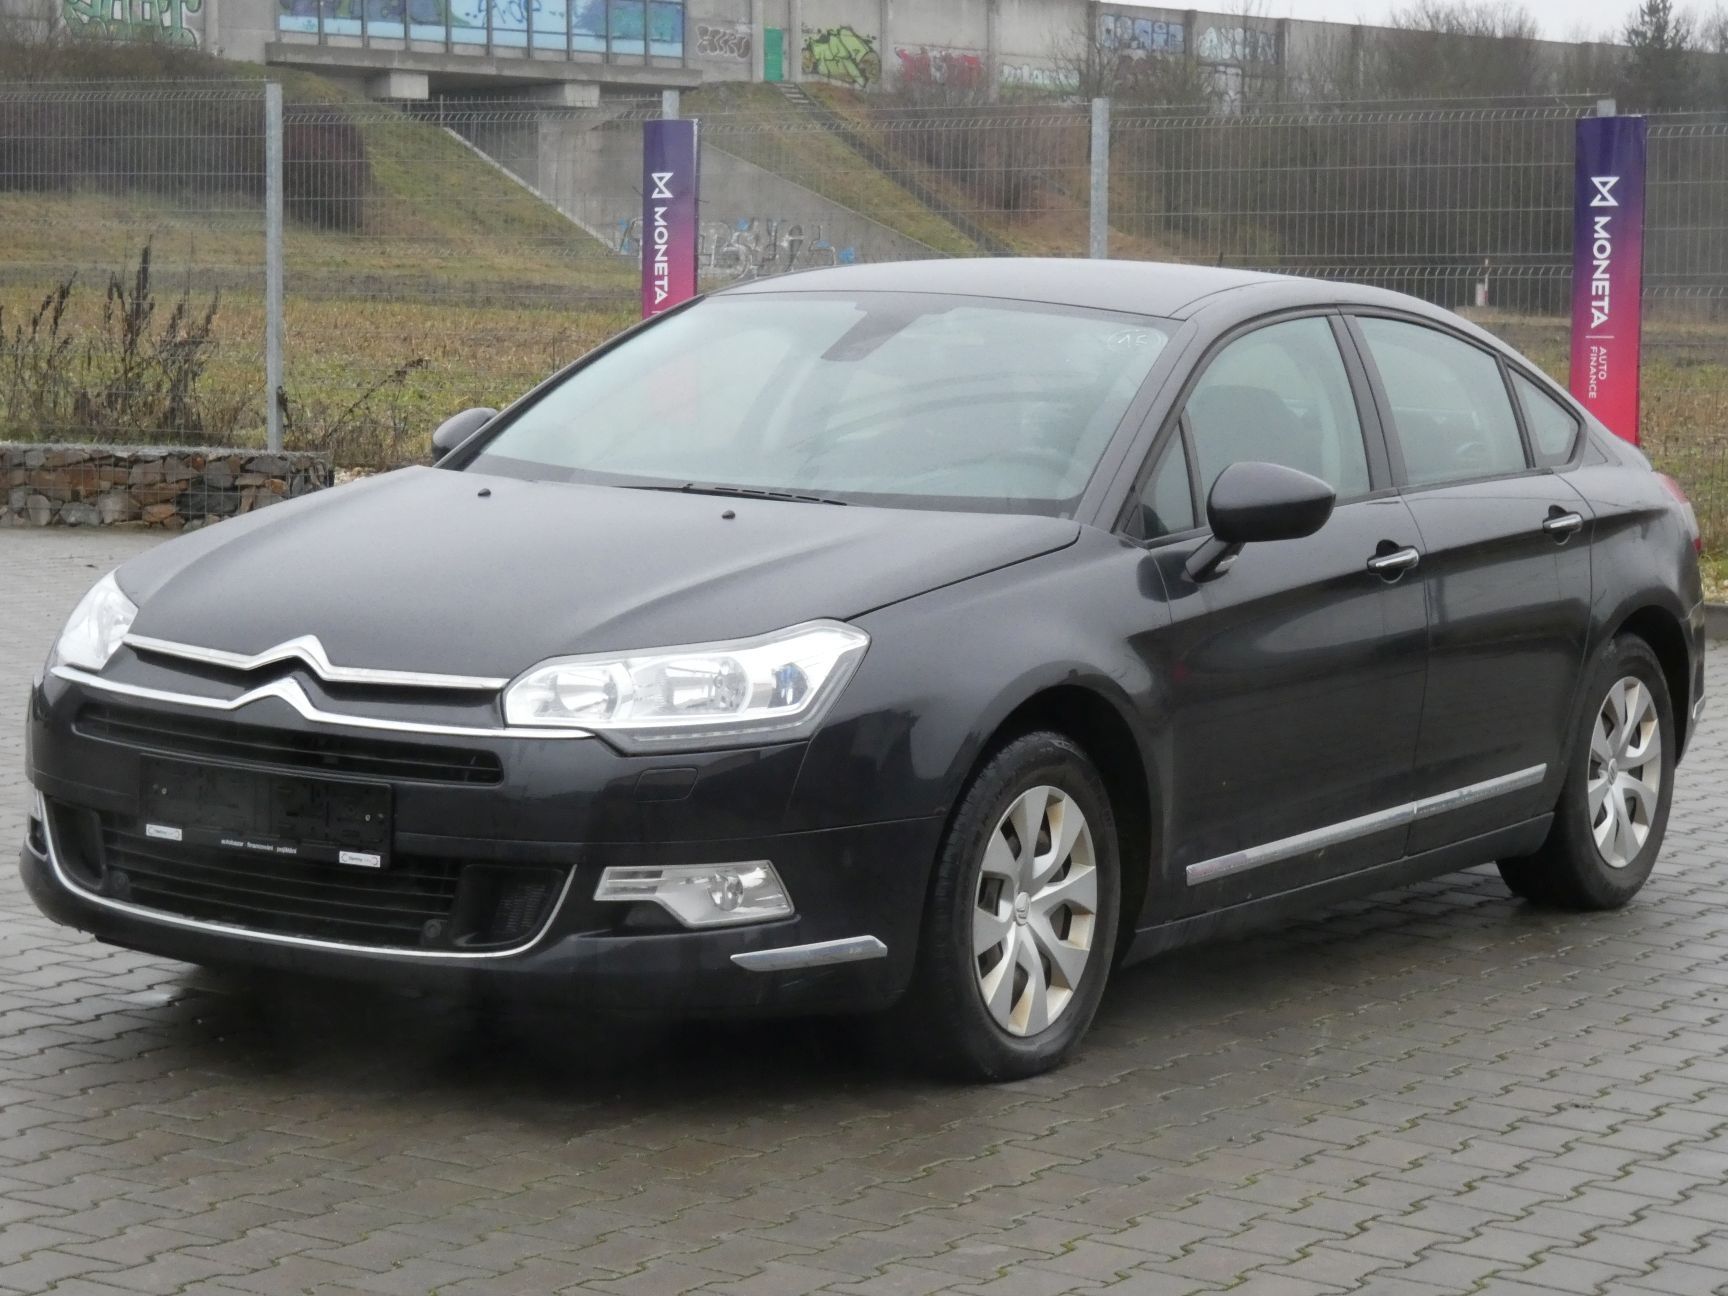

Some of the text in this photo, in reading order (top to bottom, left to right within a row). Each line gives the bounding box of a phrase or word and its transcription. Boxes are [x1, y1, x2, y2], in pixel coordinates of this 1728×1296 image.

[654, 206, 668, 304] MONETA
[1590, 217, 1611, 328] MONETA
[1588, 346, 1599, 399] FINANCE
[1598, 346, 1607, 380] AUTO
